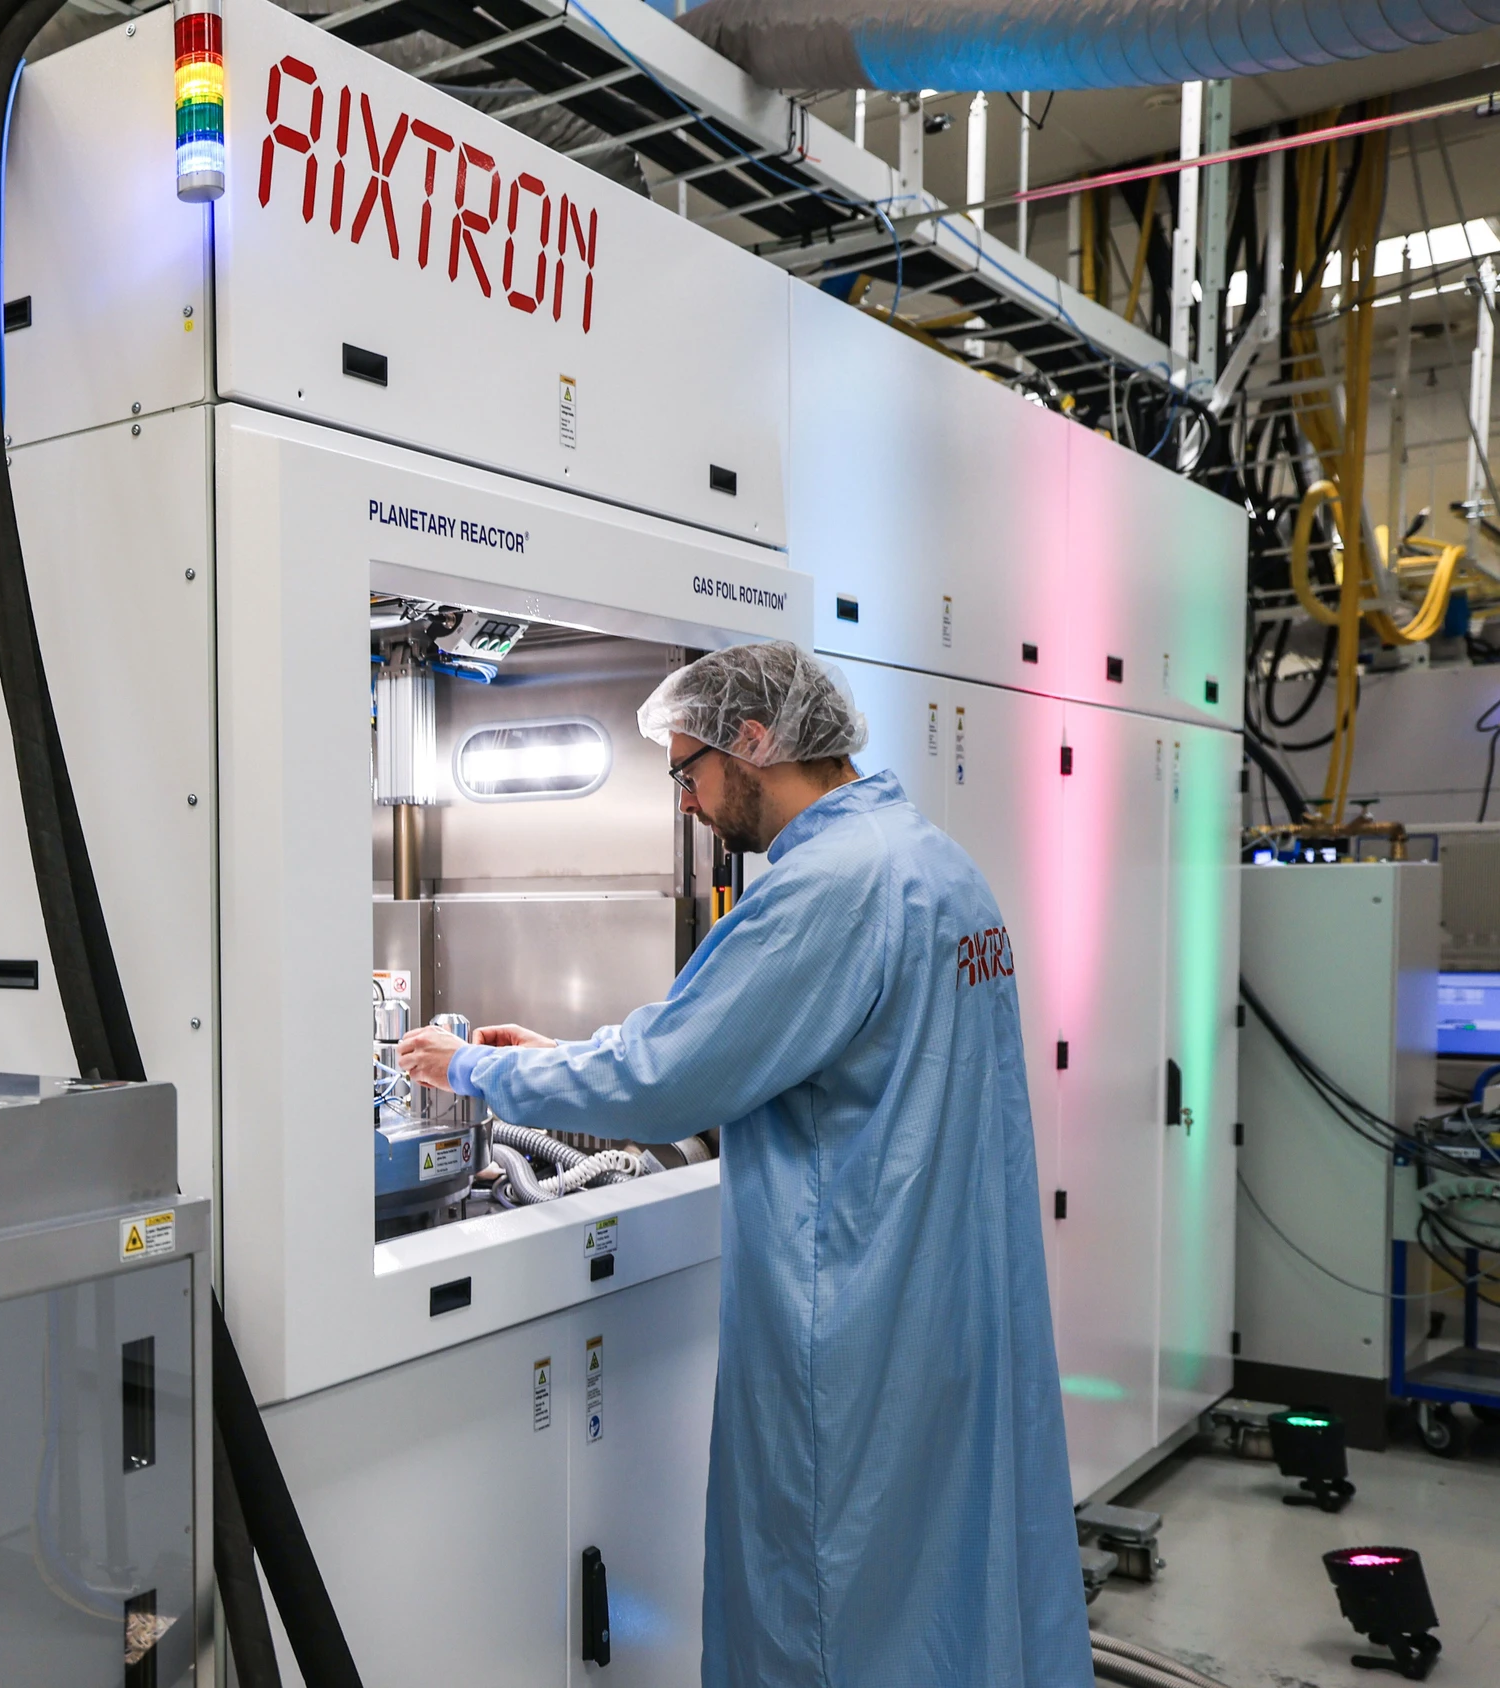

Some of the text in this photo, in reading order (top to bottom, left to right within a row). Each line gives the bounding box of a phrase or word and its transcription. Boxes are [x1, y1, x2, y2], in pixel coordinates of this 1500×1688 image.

[258, 54, 598, 335] AIXTRON
[369, 499, 456, 538] PLANETARY
[693, 576, 714, 596] GAS
[716, 580, 737, 601] FOIL
[956, 926, 1015, 991] AIXTRO
